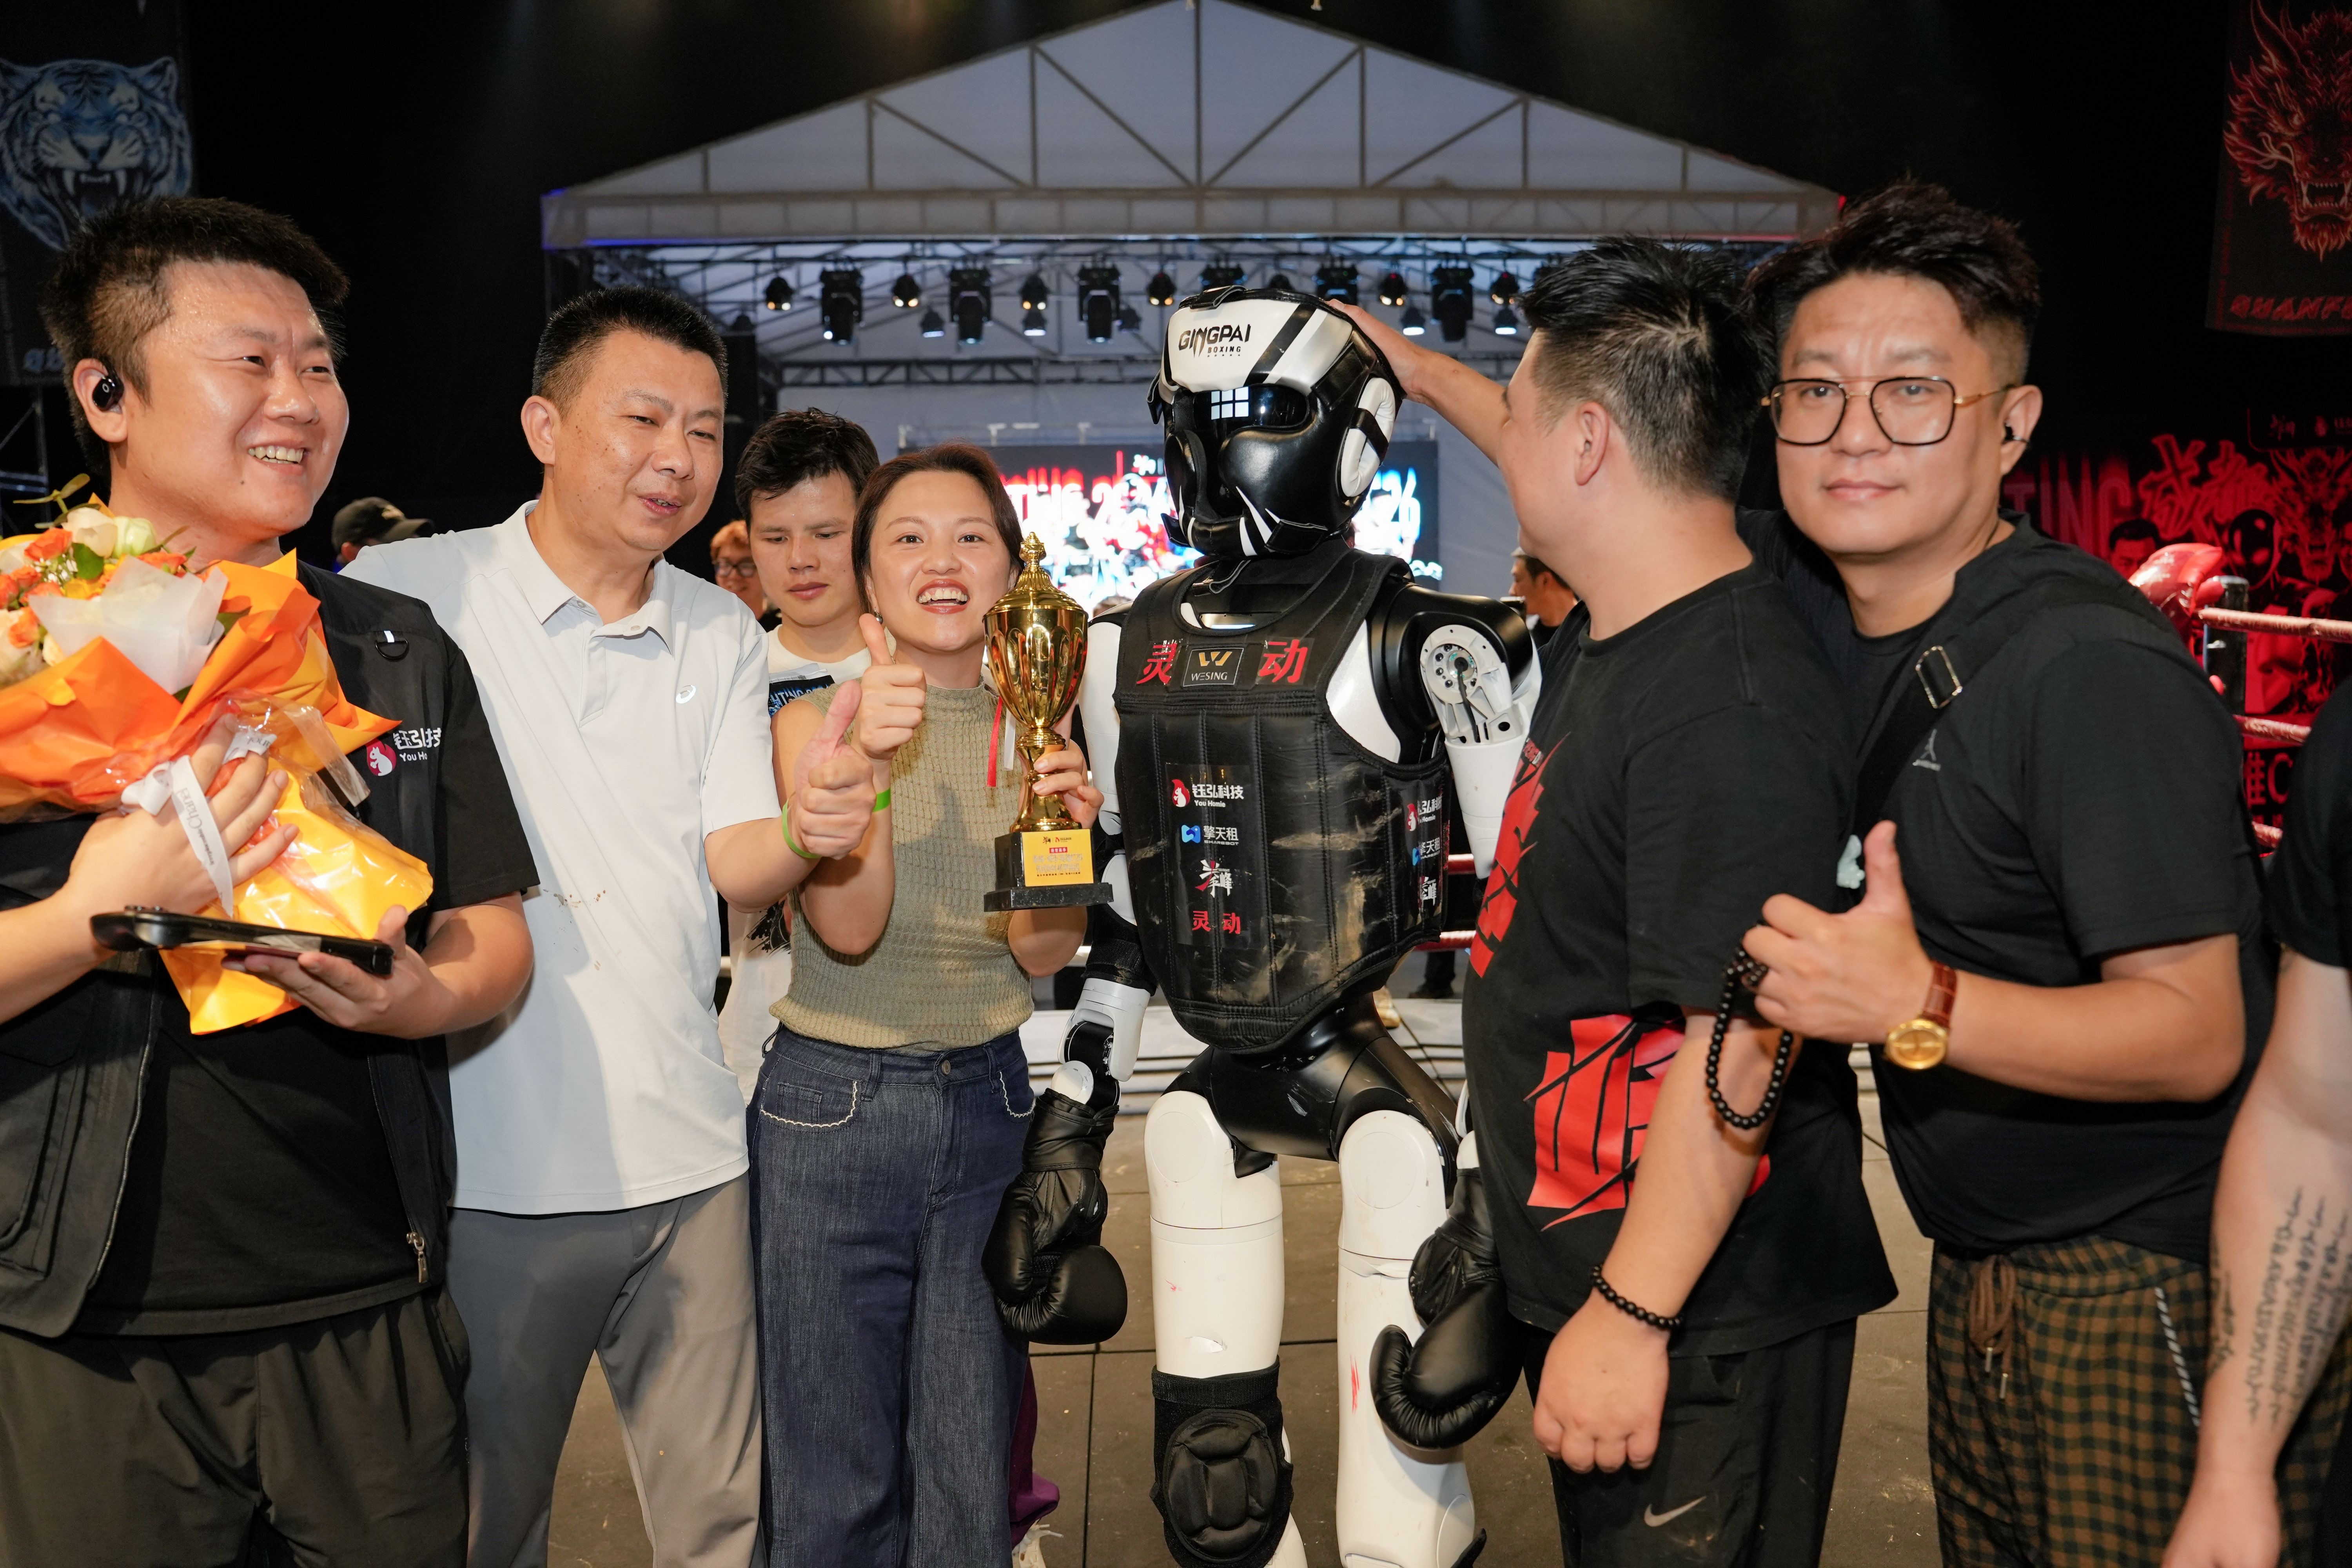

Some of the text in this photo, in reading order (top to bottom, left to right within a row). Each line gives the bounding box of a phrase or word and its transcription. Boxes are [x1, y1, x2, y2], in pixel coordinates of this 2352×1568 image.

[1179, 324, 1251, 358] GINGPAI
[1136, 639, 1308, 684] 灵 动
[1191, 671, 1228, 681] WESING
[399, 752, 417, 762] You
[1192, 784, 1244, 800] 钰弘科技
[176, 787, 202, 829] Chanel
[1203, 826, 1239, 841] 擎天租
[1192, 910, 1241, 934] 灵 动
